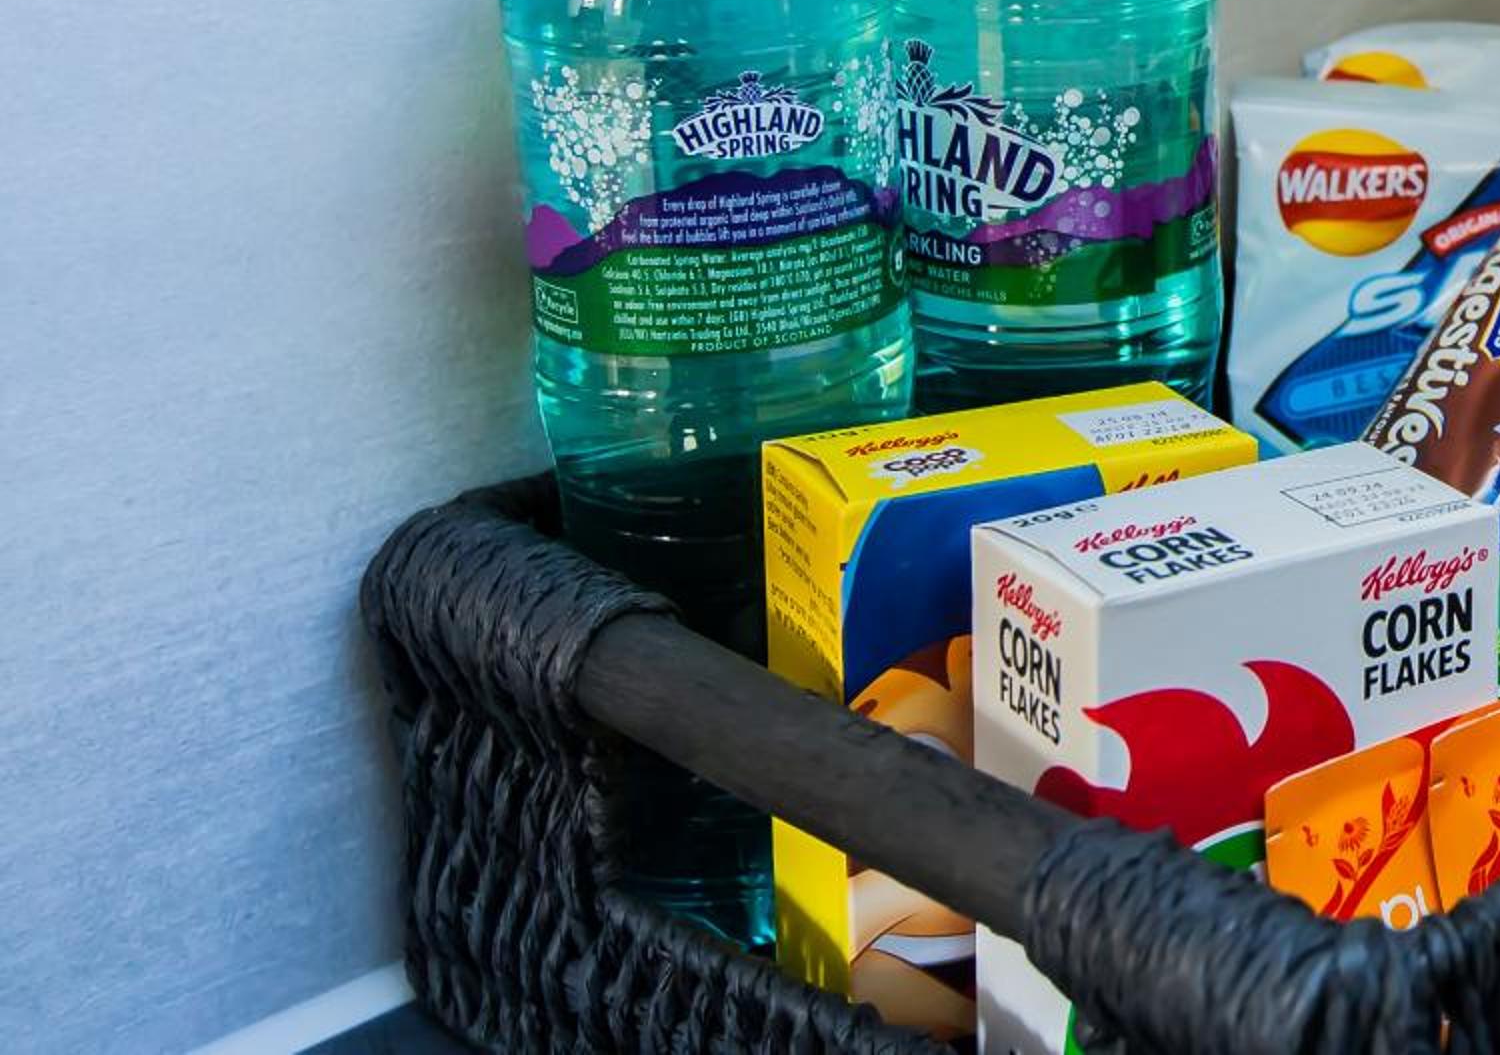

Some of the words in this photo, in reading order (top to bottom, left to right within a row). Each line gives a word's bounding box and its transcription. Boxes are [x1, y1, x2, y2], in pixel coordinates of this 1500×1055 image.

[676, 106, 821, 152] HIGHLAND
[717, 134, 790, 158] SPRING
[900, 106, 1055, 203] HLAND
[901, 165, 983, 218] RING
[1280, 162, 1427, 204] WALKERS
[909, 232, 981, 265] RKLING
[690, 338, 747, 352] PRODUCT
[753, 336, 769, 347] OF
[775, 324, 832, 344] SCOTLAND
[1331, 366, 1397, 401] BES
[846, 430, 960, 458] Kellogg's
[1074, 514, 1198, 553] Kellogg's
[1099, 528, 1235, 570] CORN
[1127, 545, 1254, 584] FLAKES
[997, 571, 1061, 641] Kellogg's
[1362, 587, 1473, 658] CORN
[1000, 618, 1061, 705] CORN
[1363, 638, 1472, 701] FLAKES
[1000, 669, 1061, 746] FLAKES
